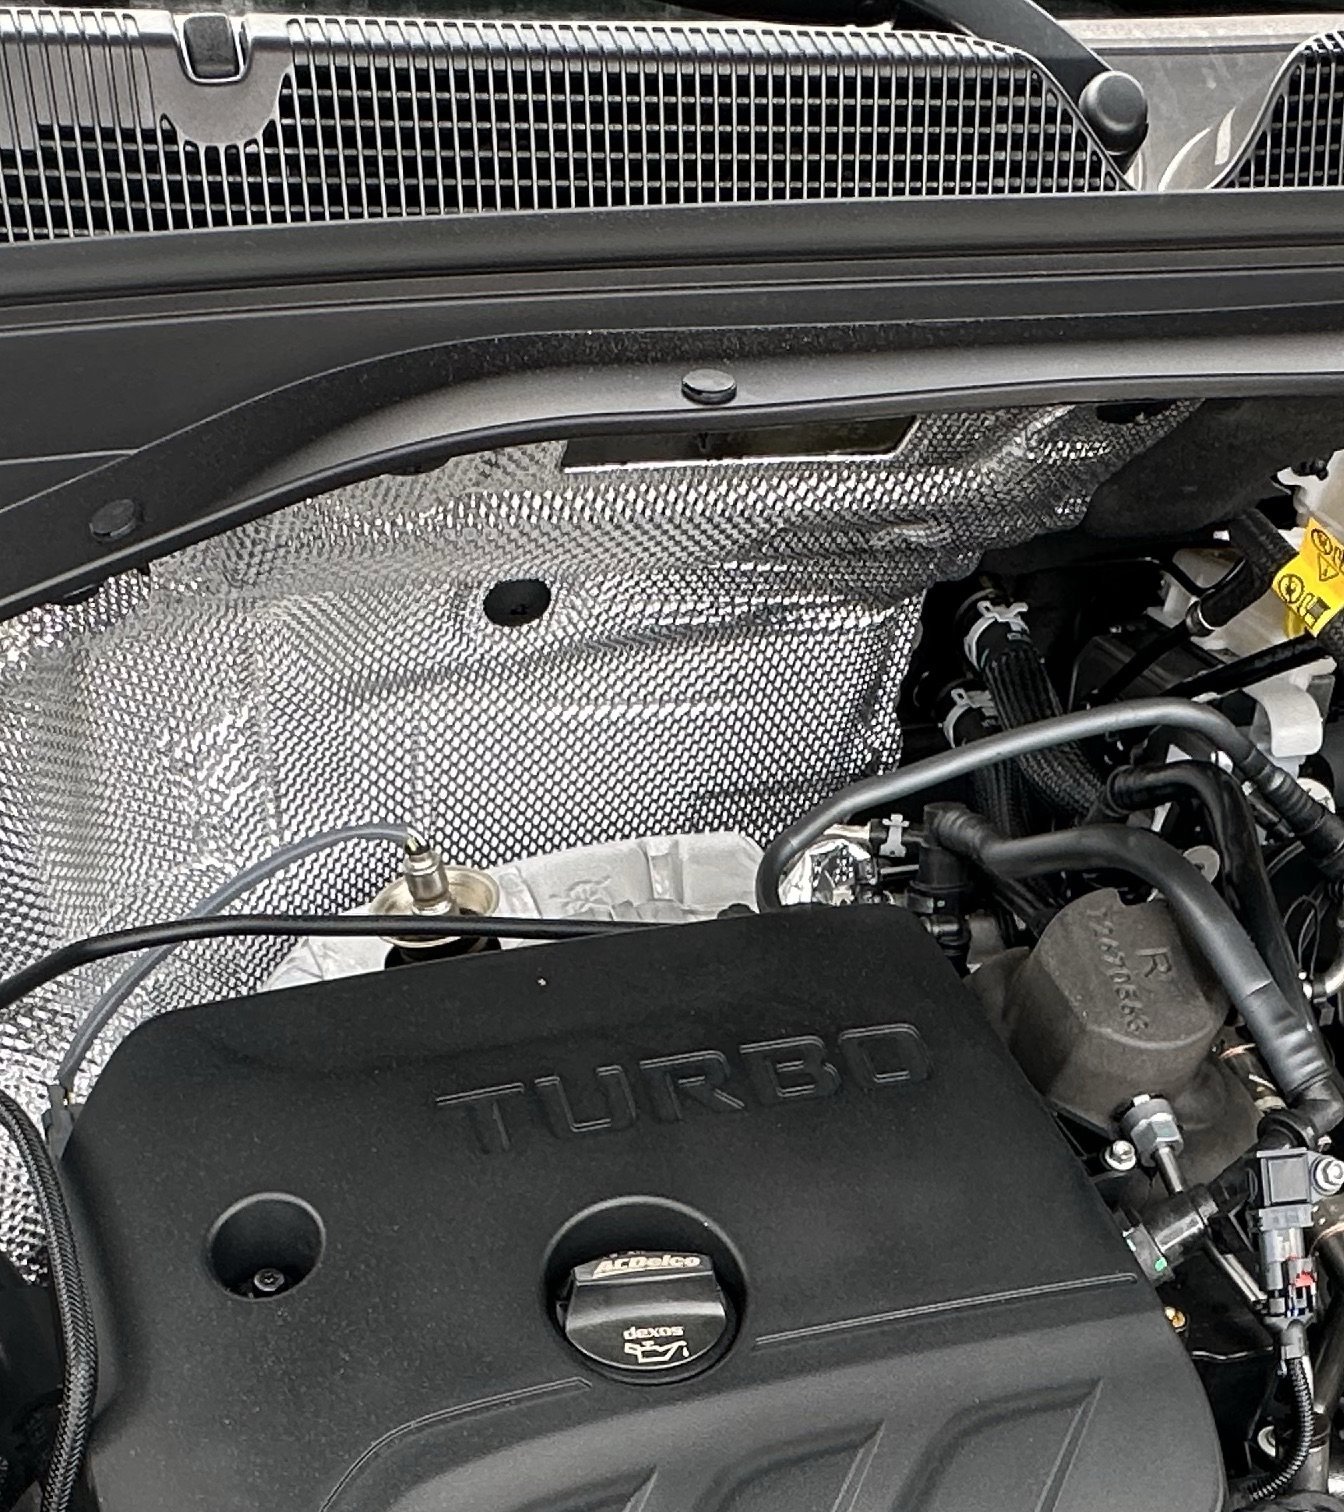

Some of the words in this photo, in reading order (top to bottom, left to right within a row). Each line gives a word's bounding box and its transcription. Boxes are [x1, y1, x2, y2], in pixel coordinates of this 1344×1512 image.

[435, 1023, 935, 1153] TURBO
[592, 1254, 702, 1279] ACDelco
[623, 1326, 685, 1340] dexos
